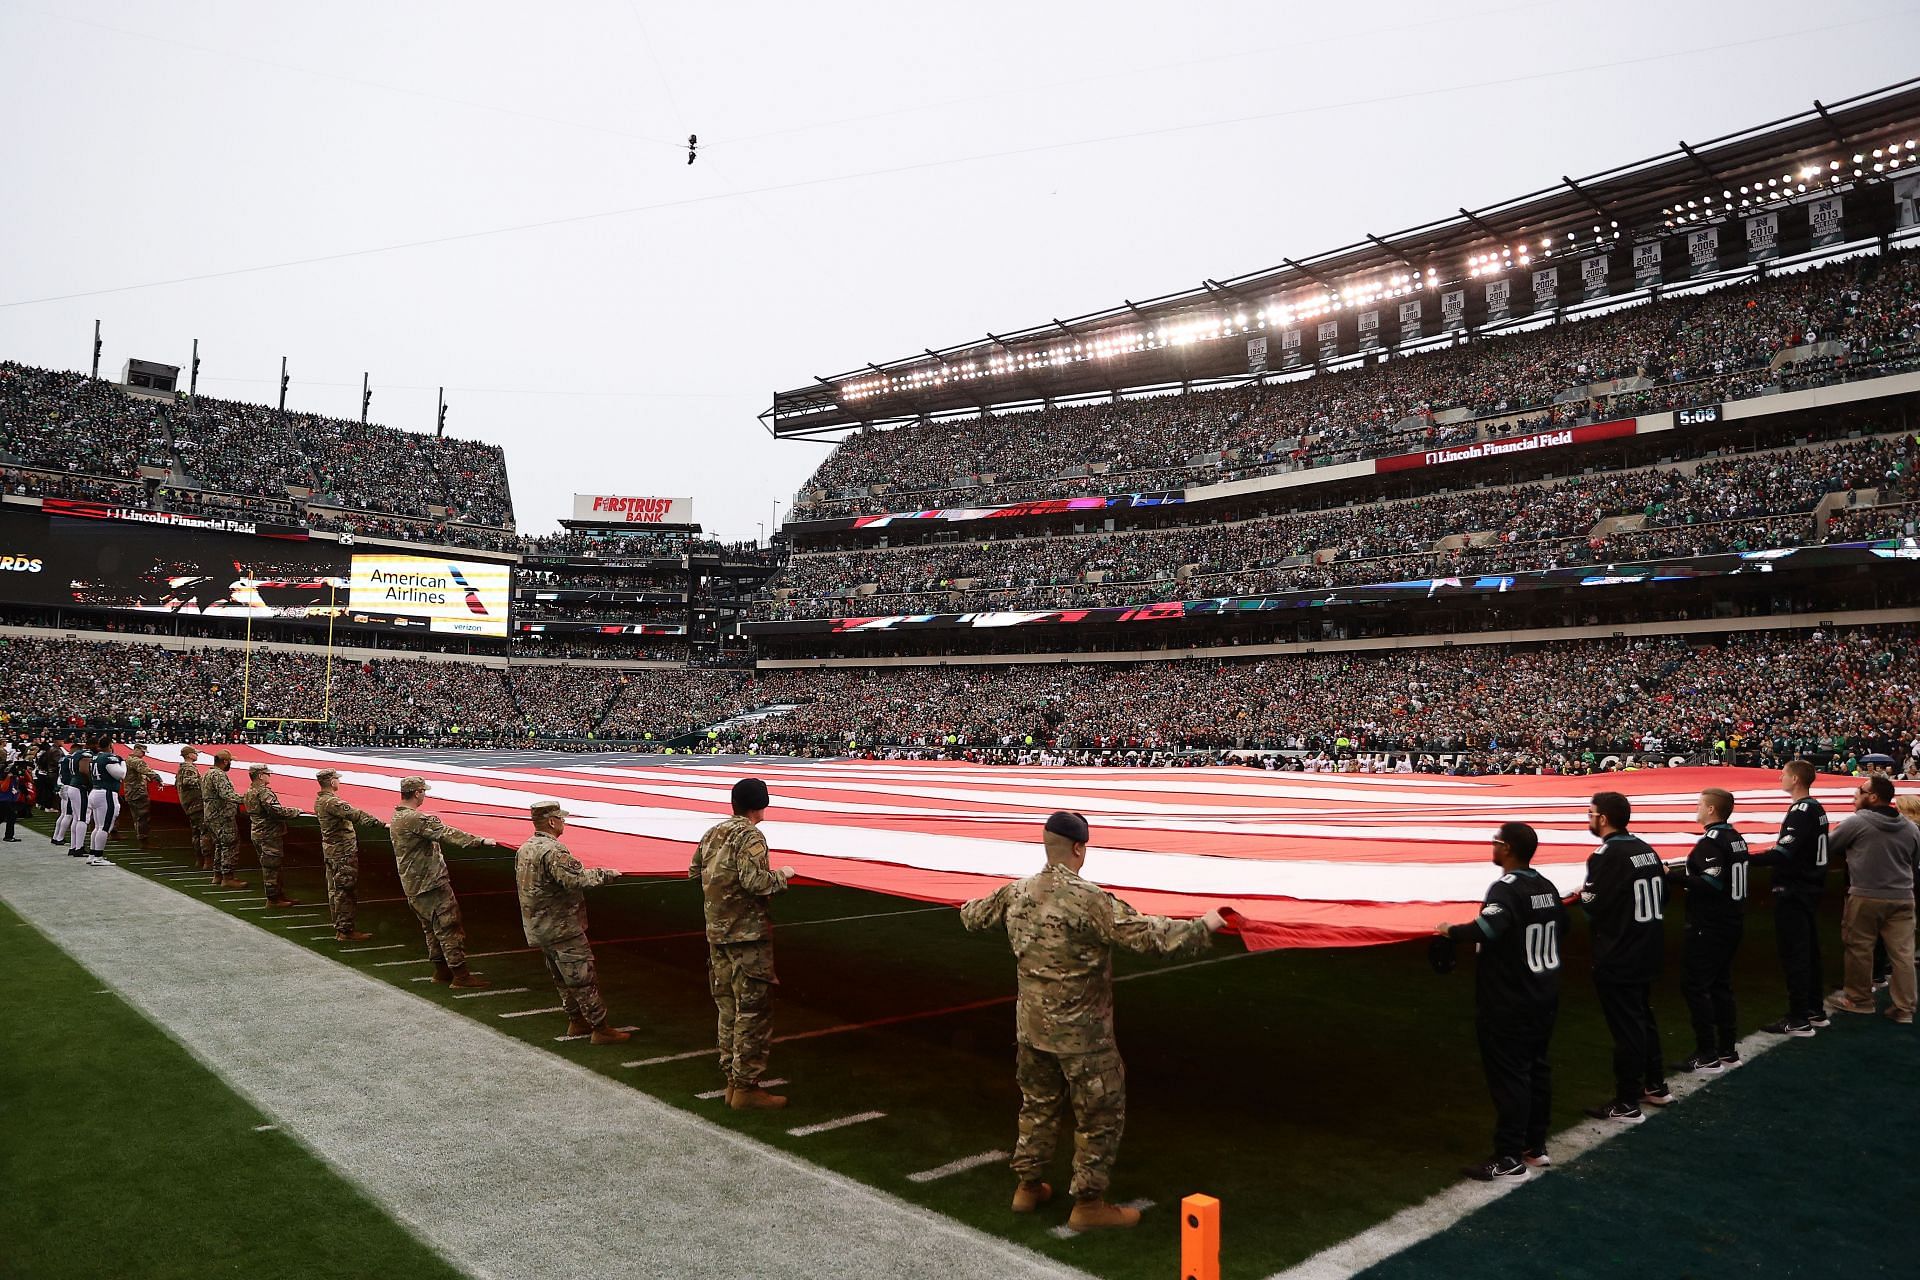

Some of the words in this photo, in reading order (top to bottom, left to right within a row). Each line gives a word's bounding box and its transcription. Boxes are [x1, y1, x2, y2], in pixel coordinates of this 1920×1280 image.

[1813, 209, 1839, 224] 2013
[1750, 225, 1773, 239] 2010
[1692, 239, 1714, 252] 2006
[1636, 253, 1657, 266] 2004
[1585, 266, 1604, 278] 2003
[1535, 279, 1555, 290] 2002
[1679, 408, 1717, 425] 5:08
[1438, 447, 1482, 463] Lincoln
[1482, 436, 1539, 456] Financial
[1539, 431, 1573, 448] Field
[121, 508, 169, 525] Lincoln
[169, 514, 226, 531] Financial
[226, 520, 256, 534] Field
[626, 512, 664, 522] BANK
[0, 556, 43, 573] RDS
[371, 569, 446, 589] American
[385, 586, 445, 604] Airlines
[454, 624, 482, 632] verizon
[1525, 920, 1560, 973] 00
